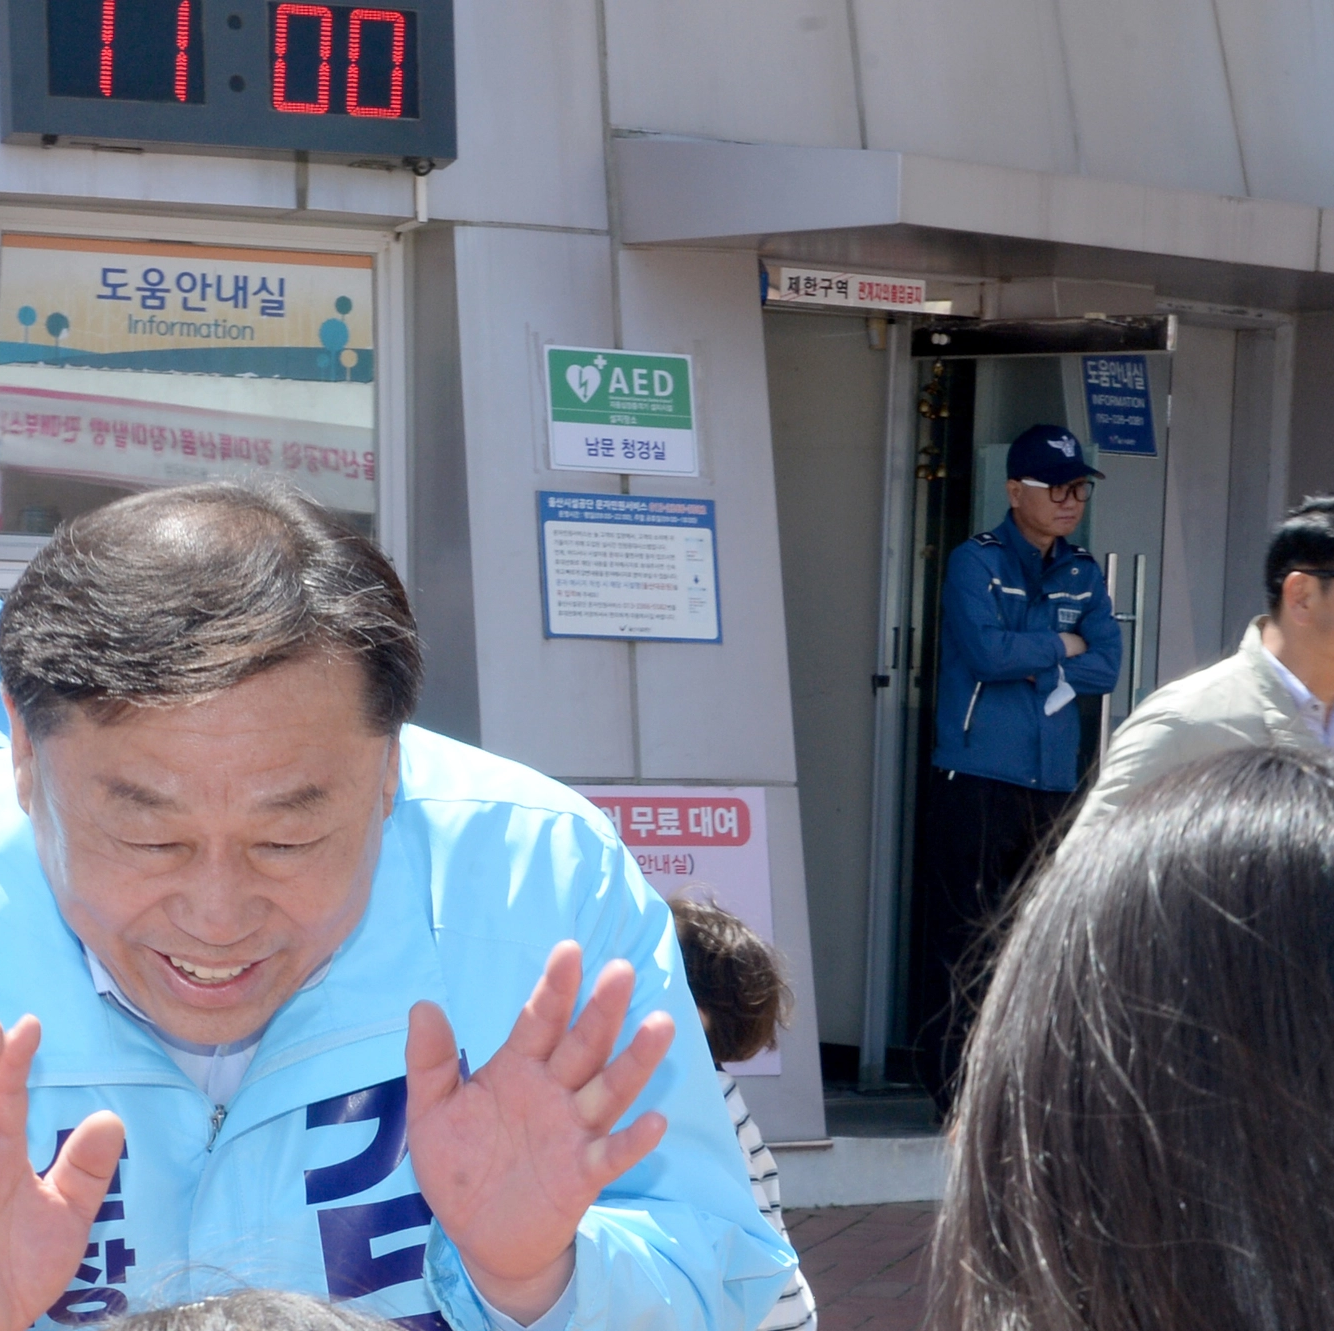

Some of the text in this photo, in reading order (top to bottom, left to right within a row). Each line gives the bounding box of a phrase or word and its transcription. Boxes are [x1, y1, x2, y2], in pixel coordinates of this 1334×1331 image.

[96, 267, 286, 318] 도움안내실
[787, 275, 849, 299] 제한구역
[128, 313, 255, 340] Information
[608, 367, 674, 397] AED
[1087, 360, 1146, 390] 도움안내실
[1092, 394, 1146, 408] INFORMATION
[585, 437, 666, 461] 남문 청경실
[630, 806, 682, 838] 무료
[688, 806, 739, 838] 대여
